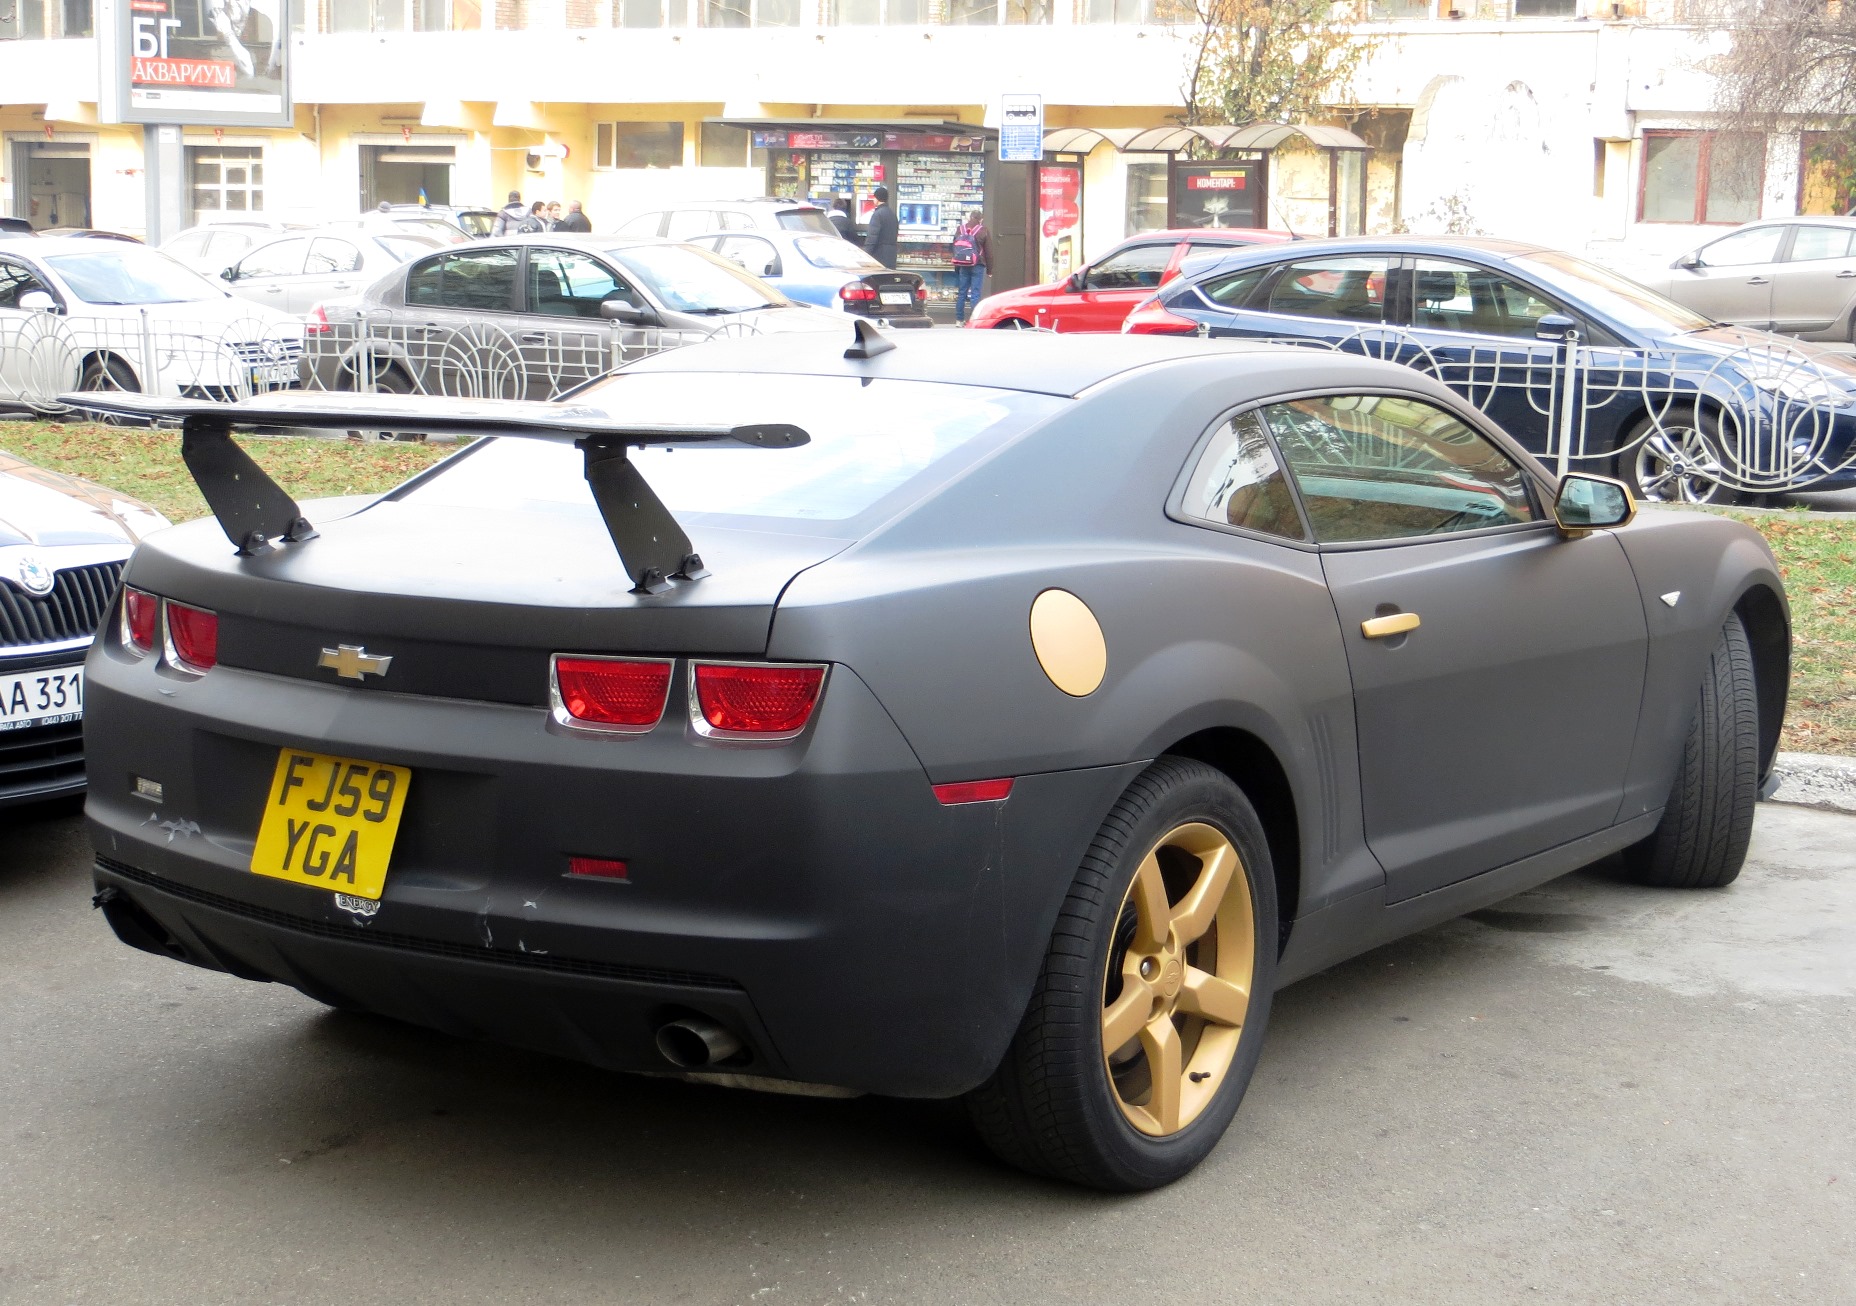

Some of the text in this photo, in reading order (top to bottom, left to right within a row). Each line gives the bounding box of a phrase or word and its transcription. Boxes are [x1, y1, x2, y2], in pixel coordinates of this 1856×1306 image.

[132, 16, 181, 58] БГ
[36, 673, 81, 710] 331
[61, 713, 73, 722] 207
[279, 755, 396, 823] FJ59
[282, 818, 359, 884] YGA
[339, 895, 378, 912] ENERGY
